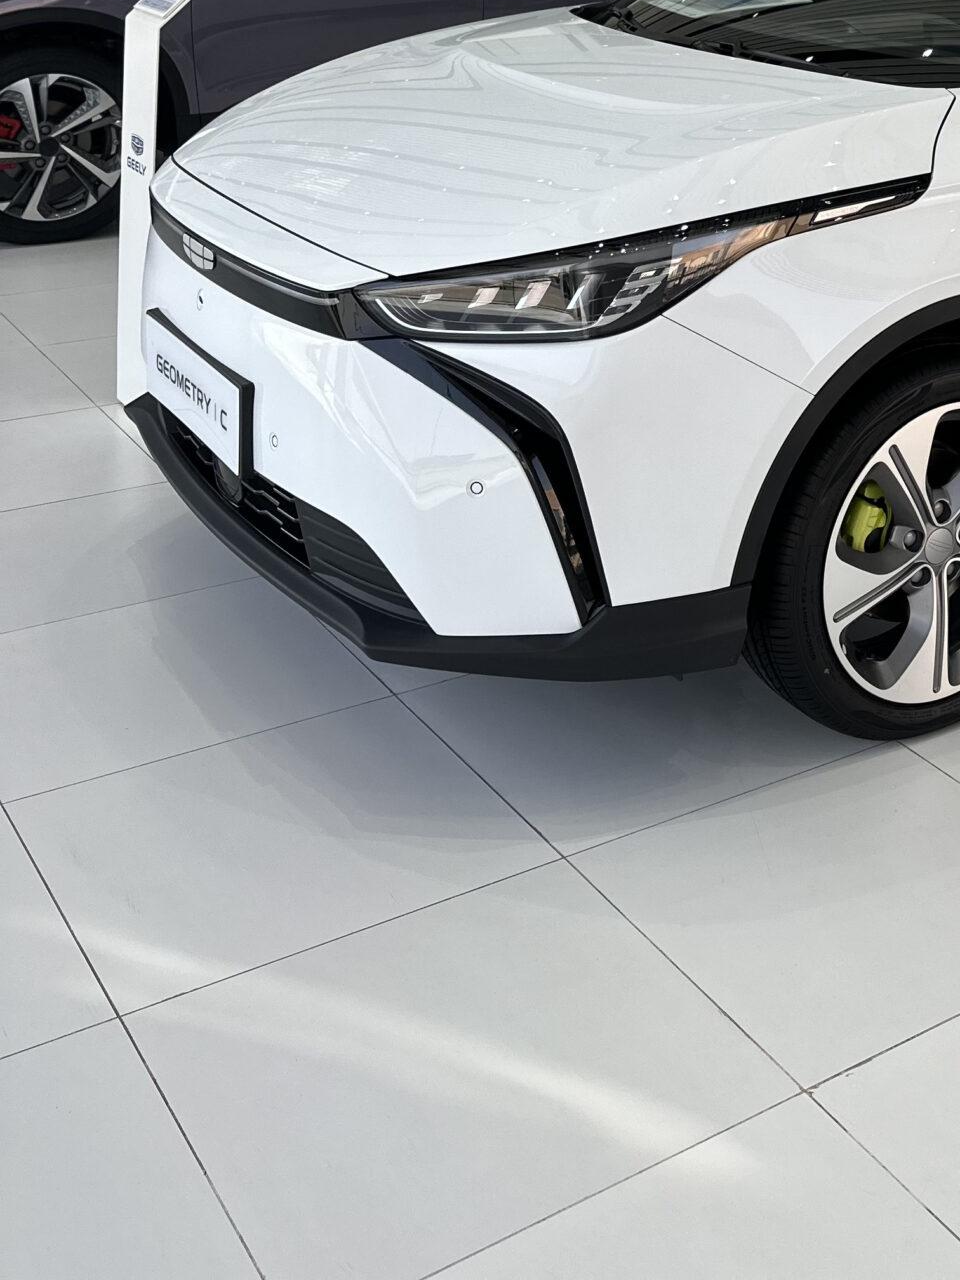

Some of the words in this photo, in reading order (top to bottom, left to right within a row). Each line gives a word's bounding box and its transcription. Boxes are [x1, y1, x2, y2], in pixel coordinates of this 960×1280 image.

[126, 156, 147, 177] GEELY
[156, 353, 212, 417] GEOMETRY
[220, 409, 228, 432] C
